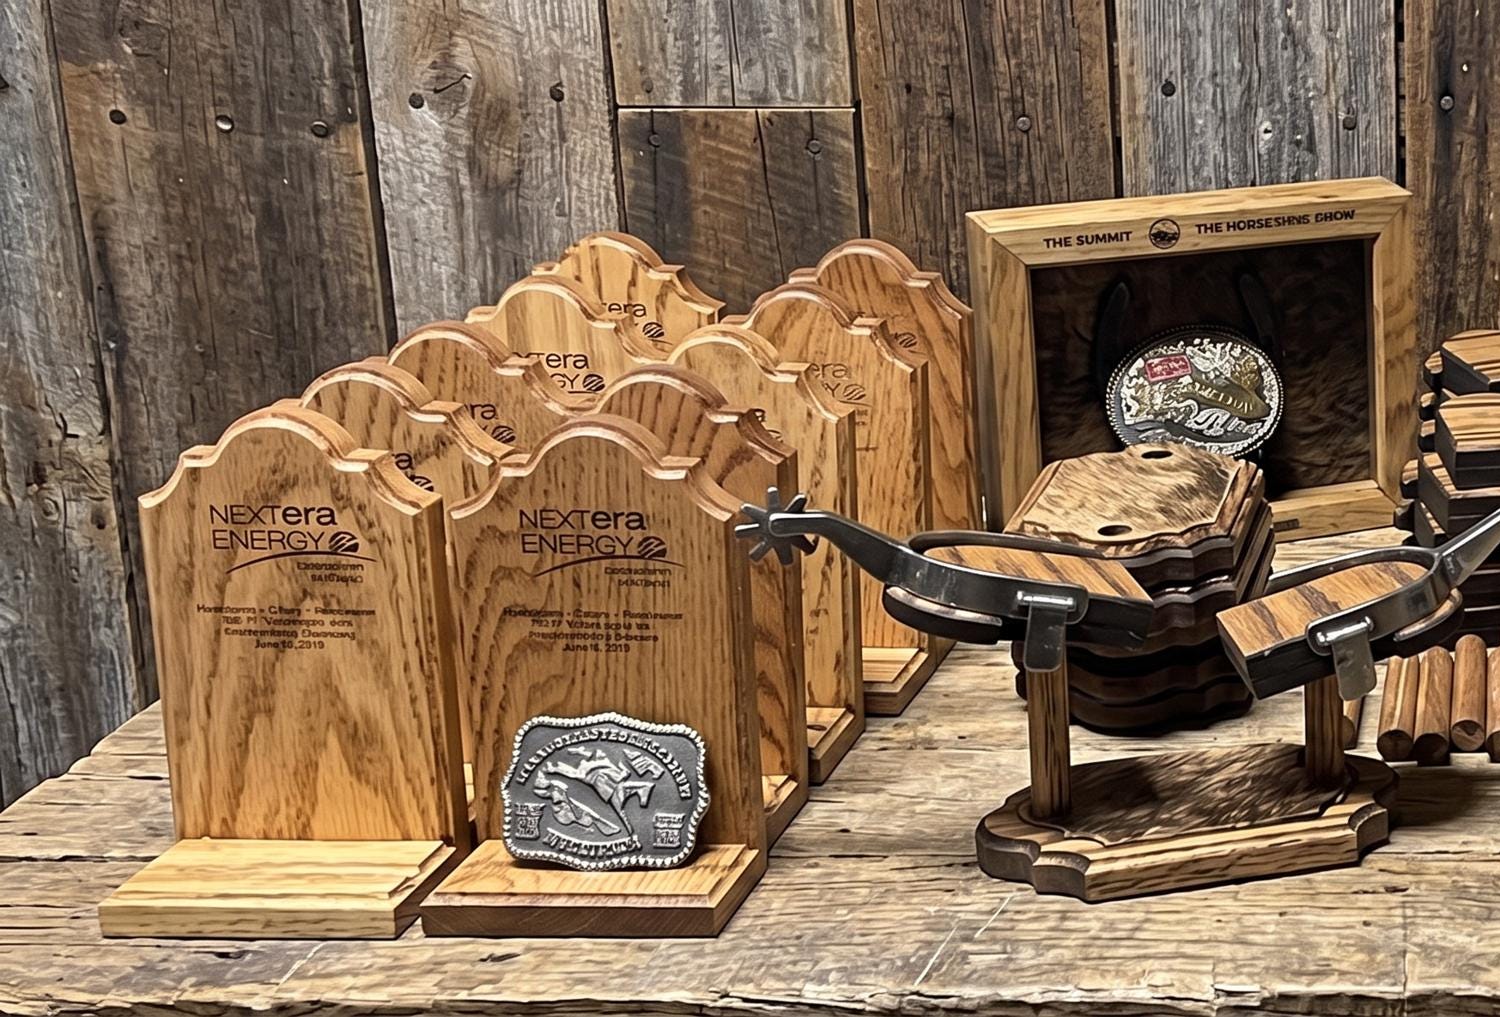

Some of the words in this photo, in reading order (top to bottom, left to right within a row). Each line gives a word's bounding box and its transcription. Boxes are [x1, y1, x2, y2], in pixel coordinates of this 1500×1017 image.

[1043, 236, 1073, 249] THE
[1076, 231, 1133, 246] SUMMIT
[1195, 222, 1224, 235] THE
[209, 504, 338, 526] NEXTera
[519, 509, 647, 531] NEXTera
[212, 529, 325, 551] ENERGY
[521, 533, 634, 556] ENERGY
